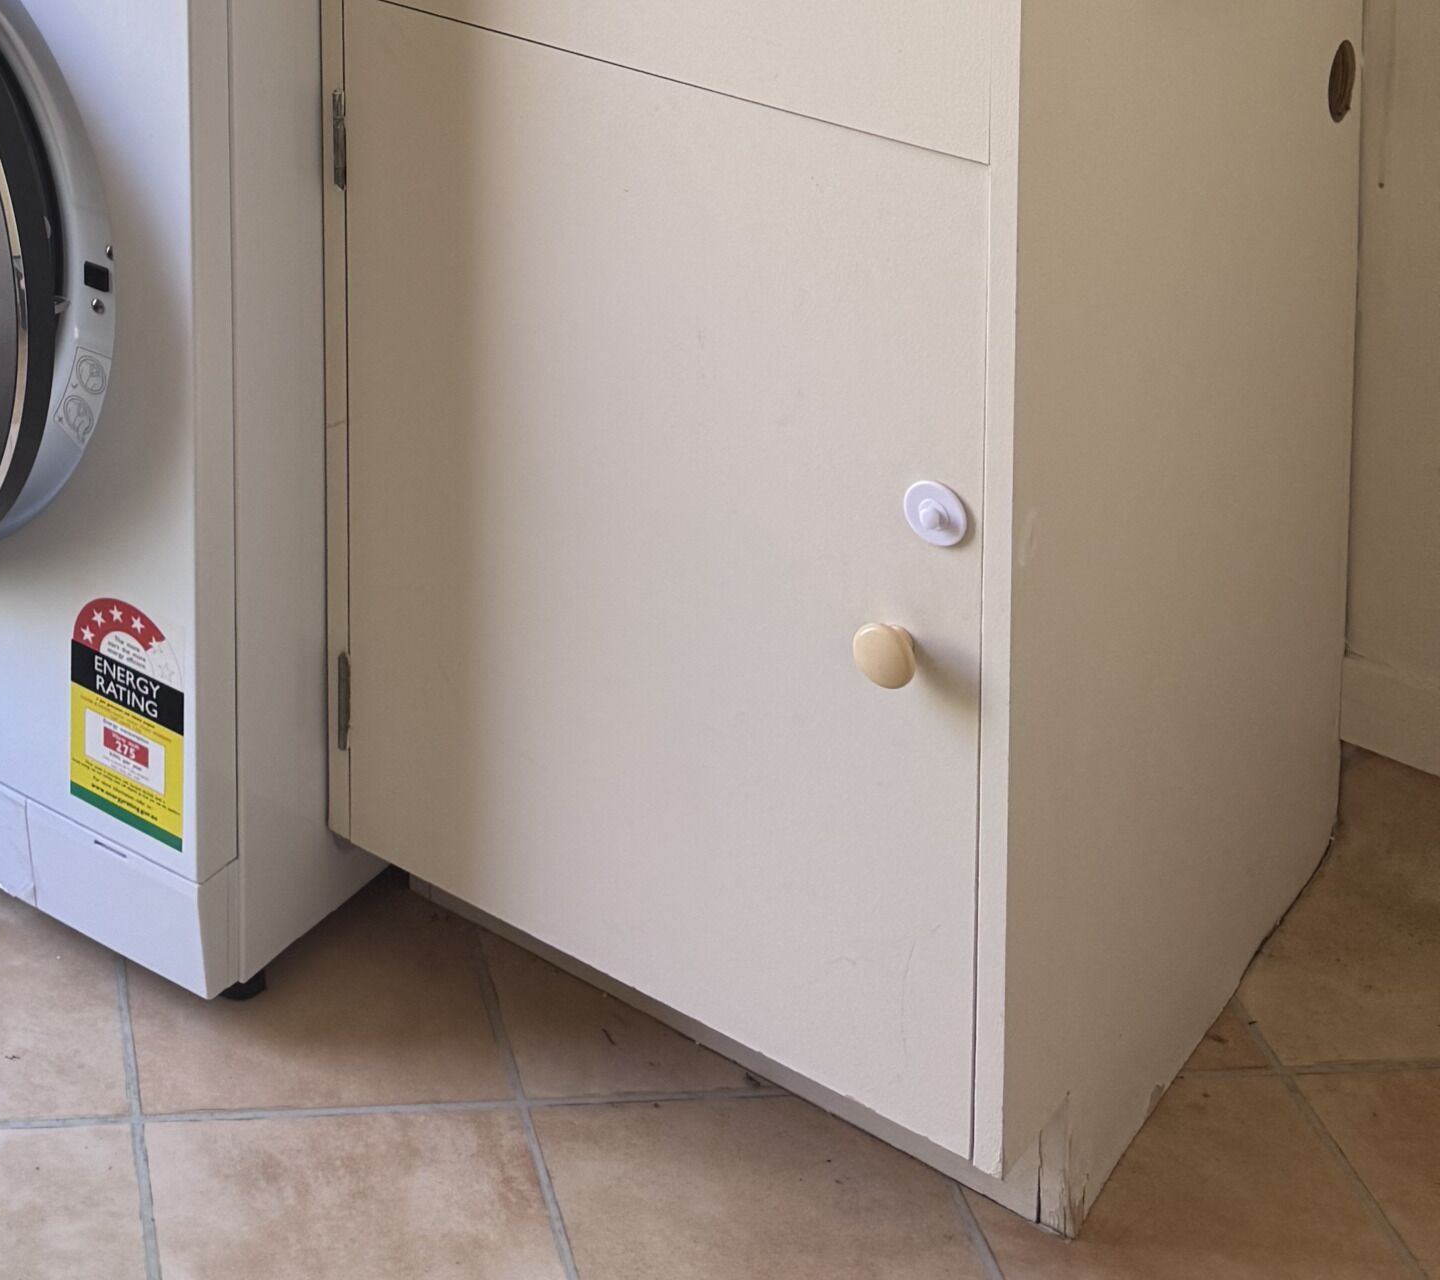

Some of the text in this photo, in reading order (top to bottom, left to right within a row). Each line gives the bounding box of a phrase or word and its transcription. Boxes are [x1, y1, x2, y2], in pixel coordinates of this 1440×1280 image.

[94, 655, 160, 699] ENERGY
[96, 674, 158, 718] RATING
[115, 741, 136, 759] 275
